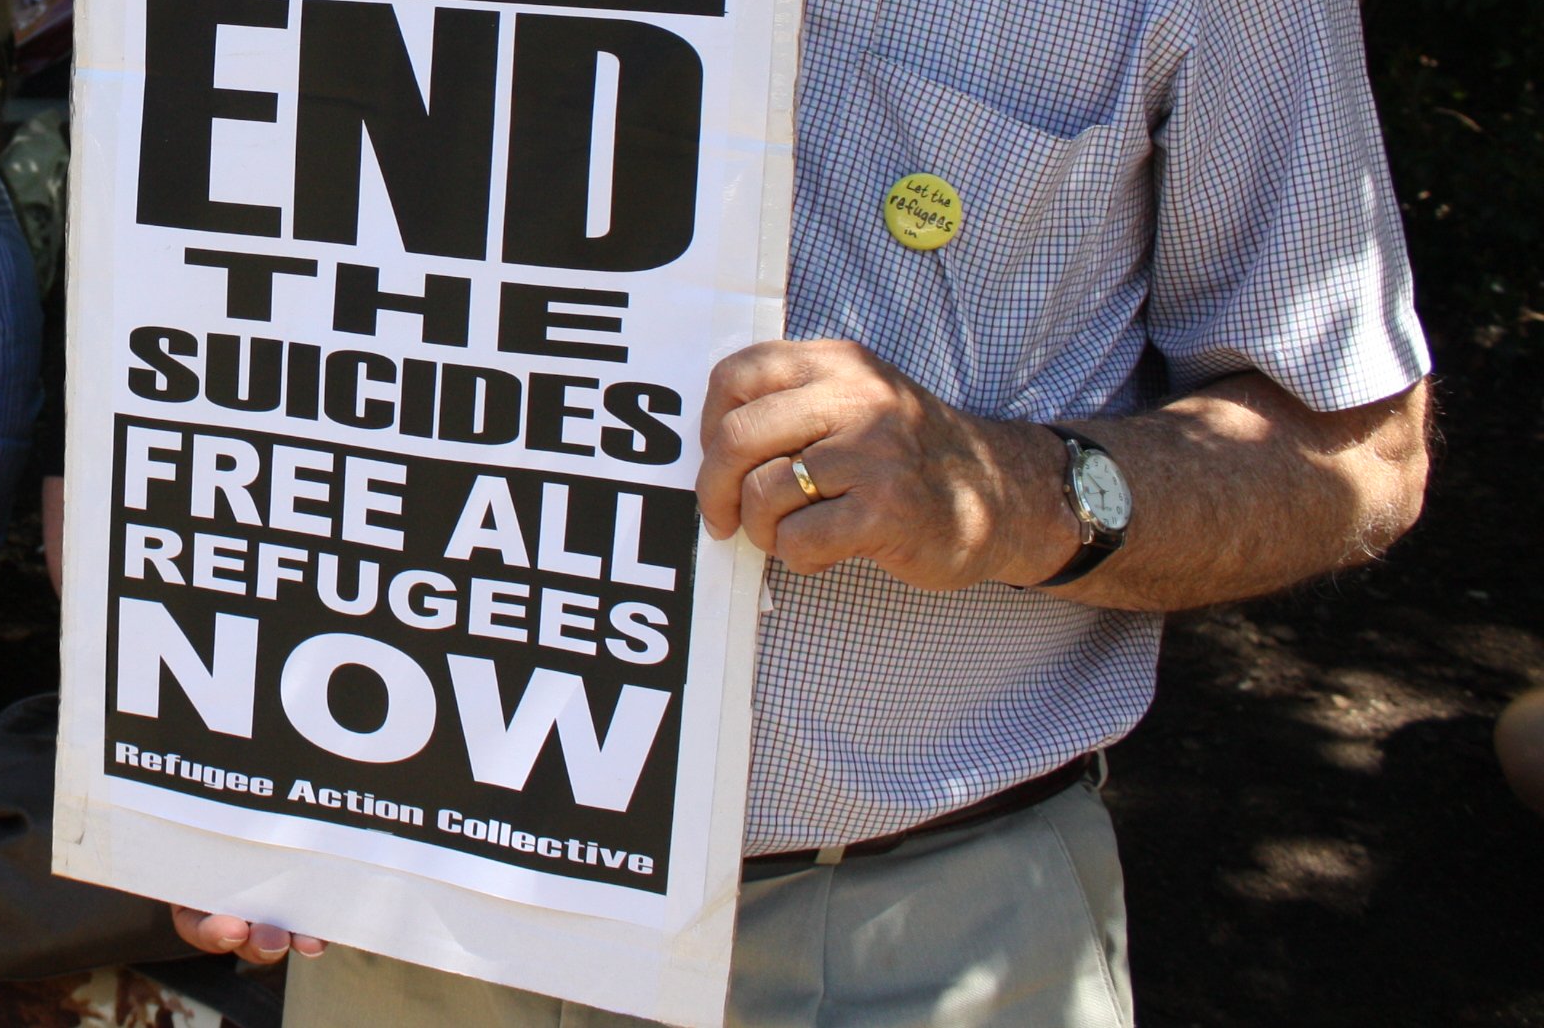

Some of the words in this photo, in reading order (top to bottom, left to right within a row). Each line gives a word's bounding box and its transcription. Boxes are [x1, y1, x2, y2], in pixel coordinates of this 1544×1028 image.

[889, 195, 954, 232] refugees
[931, 189, 951, 208] the
[184, 247, 629, 364] THE
[127, 326, 683, 466] SUICIDES
[124, 425, 408, 552] FREE
[444, 475, 678, 591] ALL
[124, 523, 670, 665] REFUGEES
[116, 596, 672, 814] NOW
[115, 741, 274, 799] Refugee
[287, 778, 424, 827] Action
[438, 809, 654, 876] Collective
